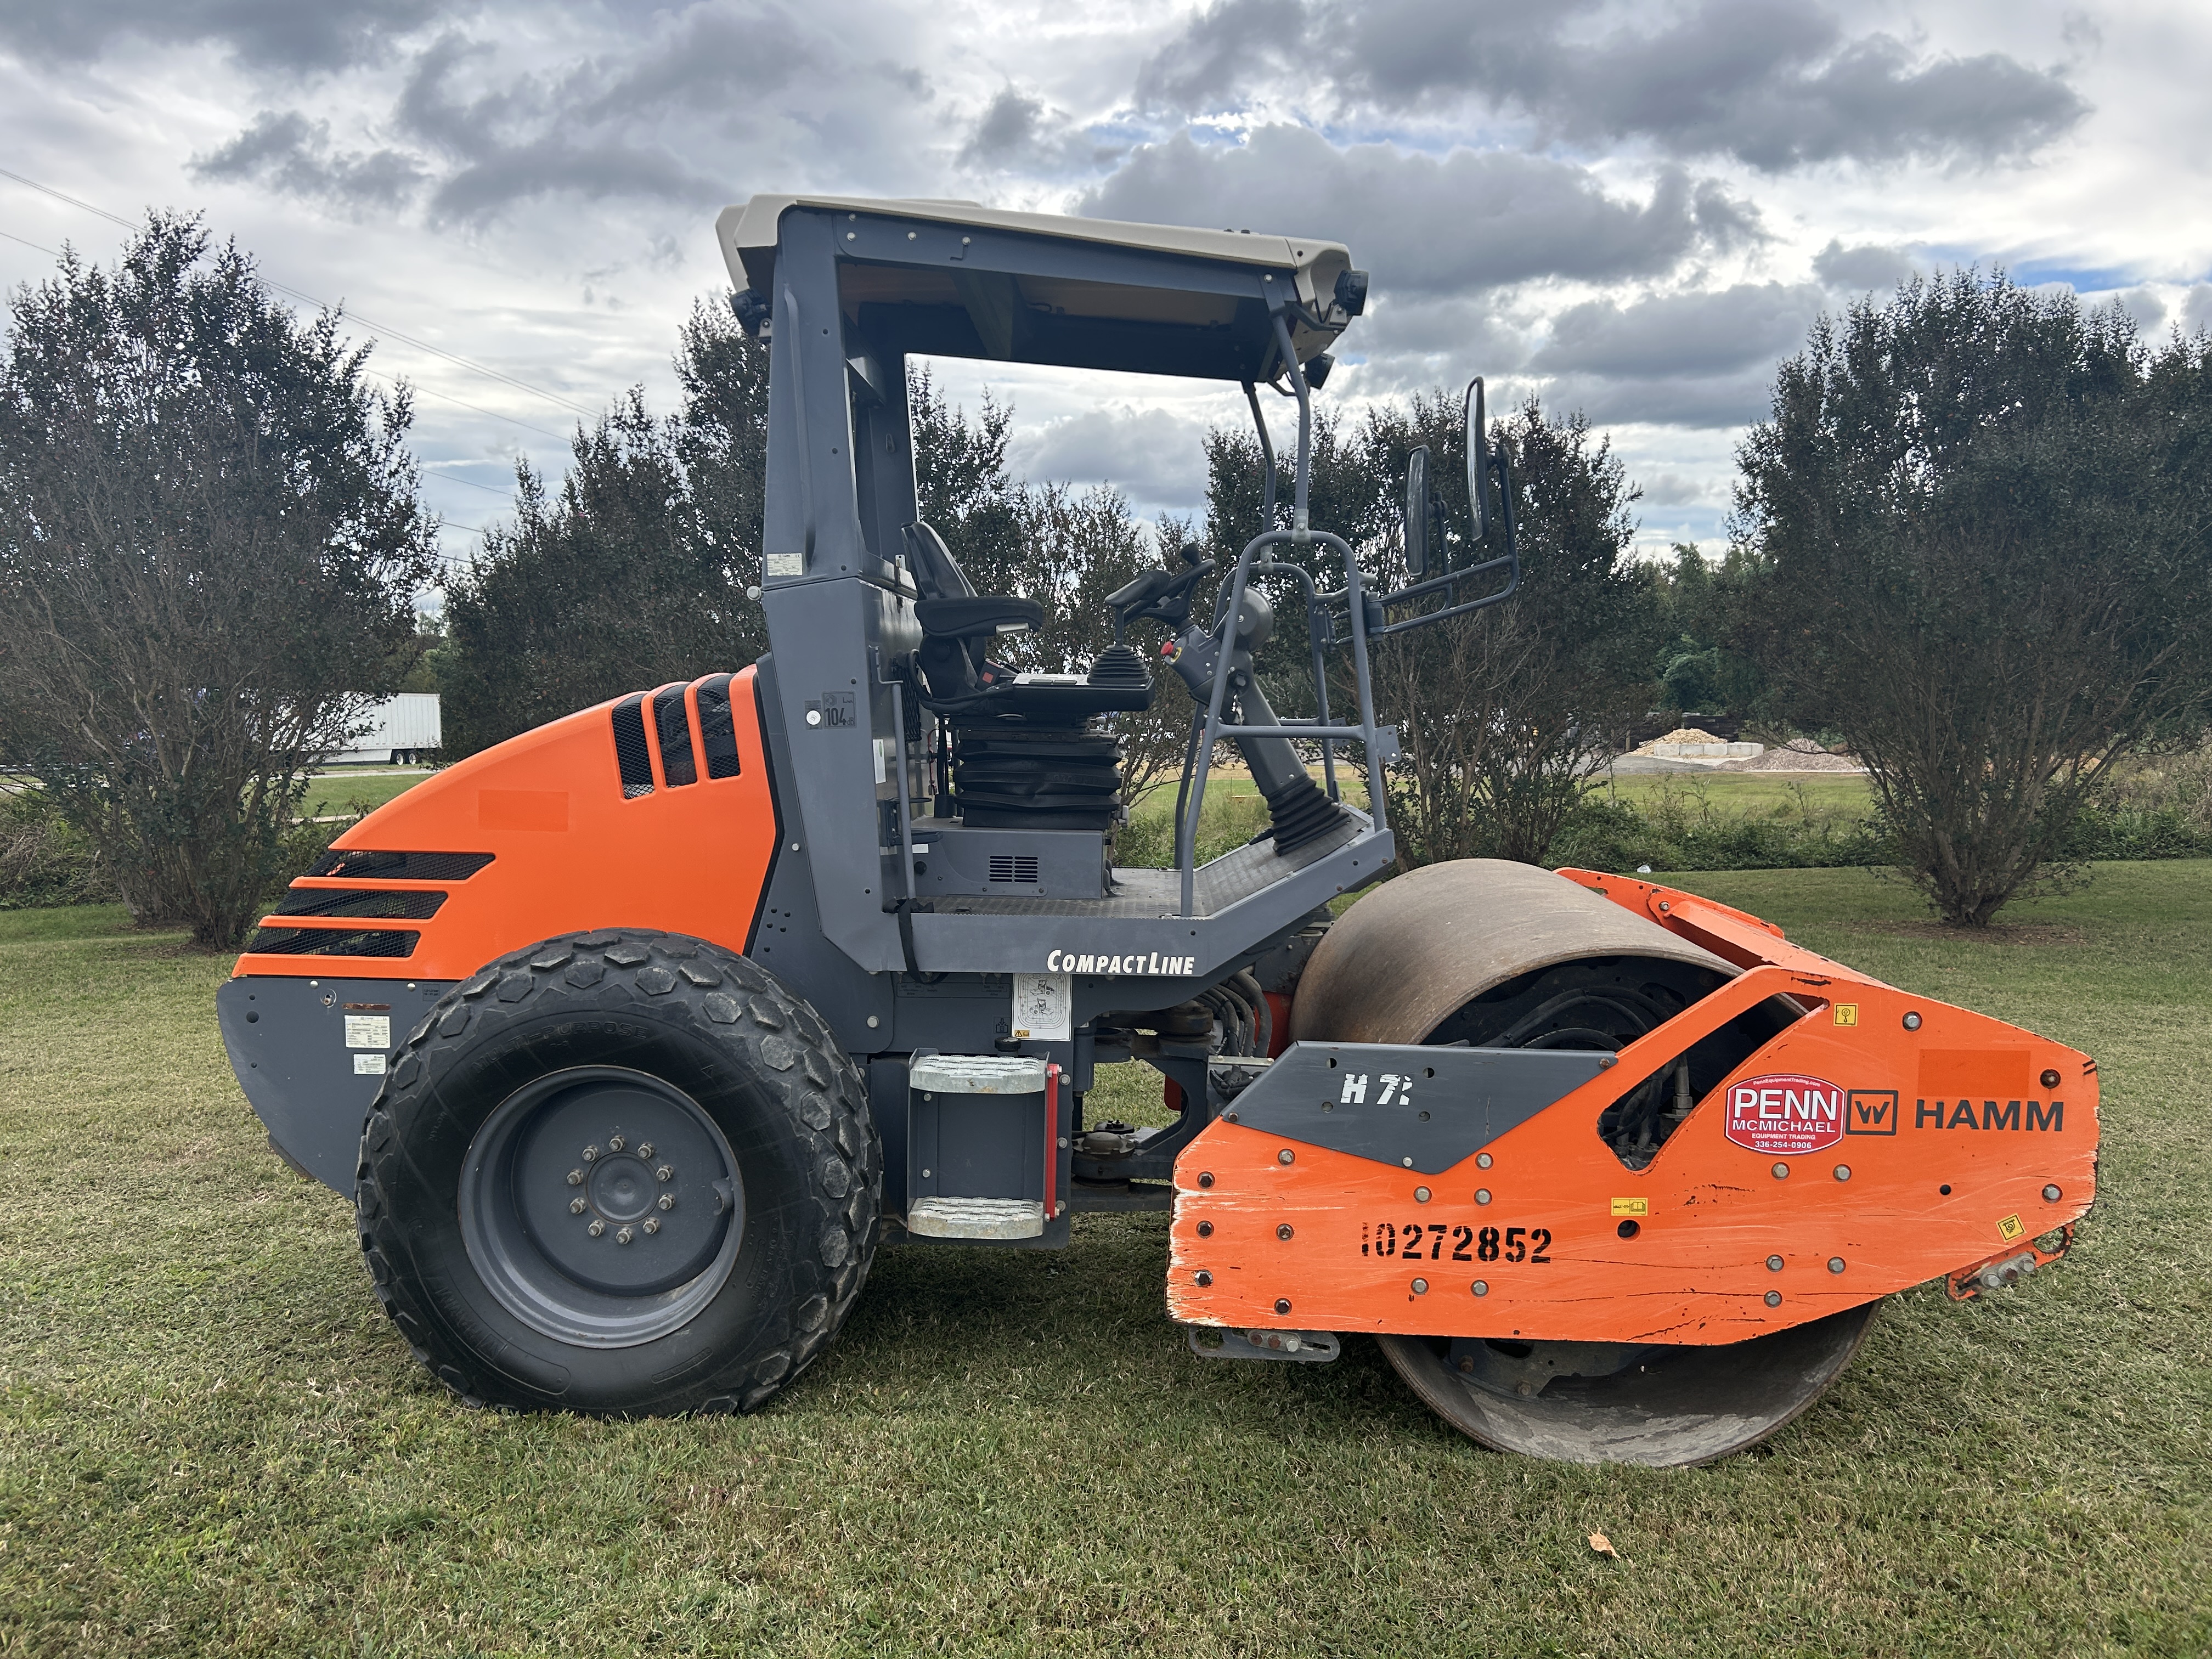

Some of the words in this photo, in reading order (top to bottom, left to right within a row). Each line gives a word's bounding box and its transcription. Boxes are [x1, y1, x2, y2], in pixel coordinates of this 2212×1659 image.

[825, 708, 847, 726] 104
[1340, 1073, 1368, 1104] H
[1734, 1088, 1837, 1120] PENN
[1732, 1120, 1836, 1132] MCMICHAEL
[1915, 1099, 2064, 1132] HAMM
[1755, 1141, 1812, 1149] 336-254-0906
[1362, 1221, 1551, 1263] 10272852
